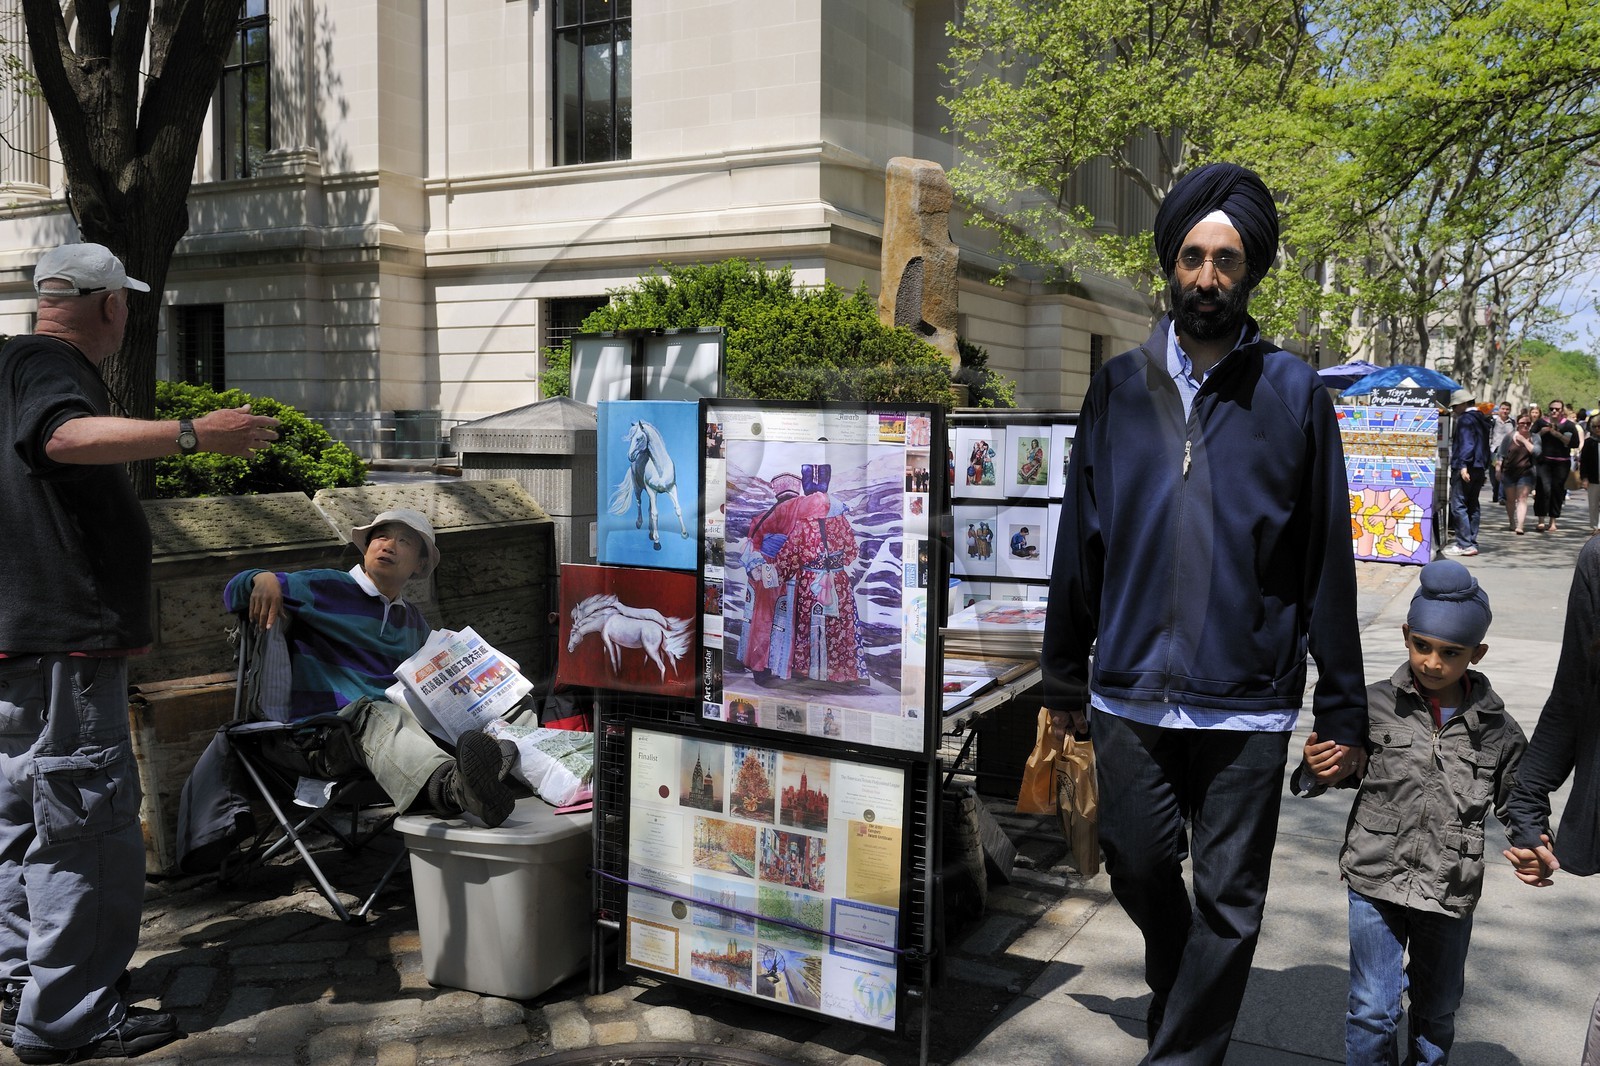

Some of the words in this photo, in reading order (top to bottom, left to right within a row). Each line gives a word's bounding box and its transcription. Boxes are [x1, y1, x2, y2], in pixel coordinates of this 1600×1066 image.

[836, 411, 860, 421] Award
[704, 649, 713, 686] Calendar
[704, 686, 713, 701] Art
[638, 751, 658, 762] Finalist
